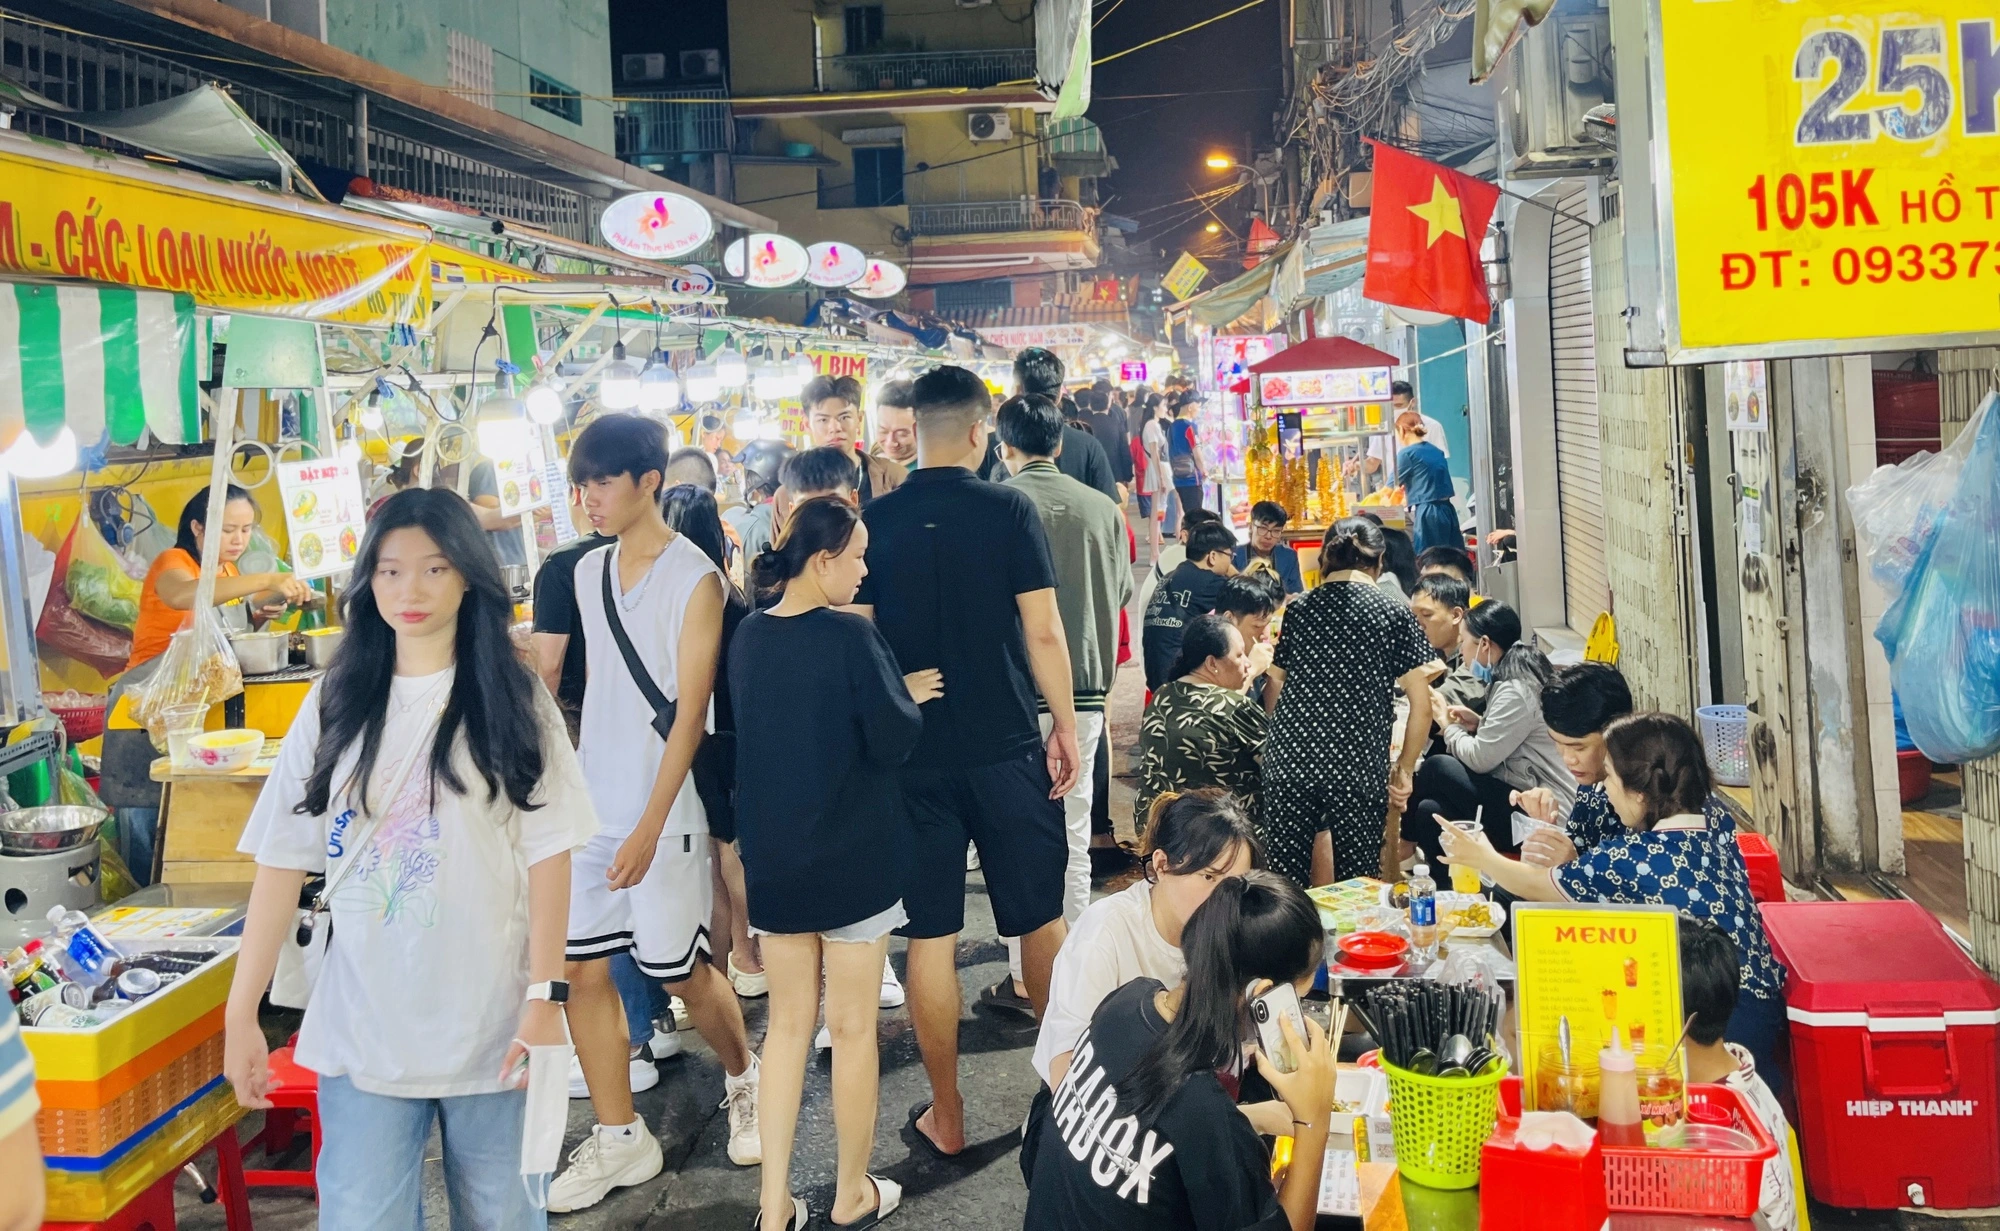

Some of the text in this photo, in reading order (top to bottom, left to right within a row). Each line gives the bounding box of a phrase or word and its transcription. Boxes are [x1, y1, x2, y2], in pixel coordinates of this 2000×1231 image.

[1747, 167, 1881, 232] 105K
[1900, 172, 1962, 225] HỒ
[55, 196, 130, 285] CÁC
[137, 224, 217, 300] LOẠI
[217, 229, 300, 298] NƯỚC
[1720, 249, 1811, 291] ĐT:
[829, 355, 866, 378] BIM
[1555, 926, 1638, 944] MENU
[1053, 1028, 1175, 1204] RADOX
[1846, 1098, 1973, 1118] HIỆP THÀNH
